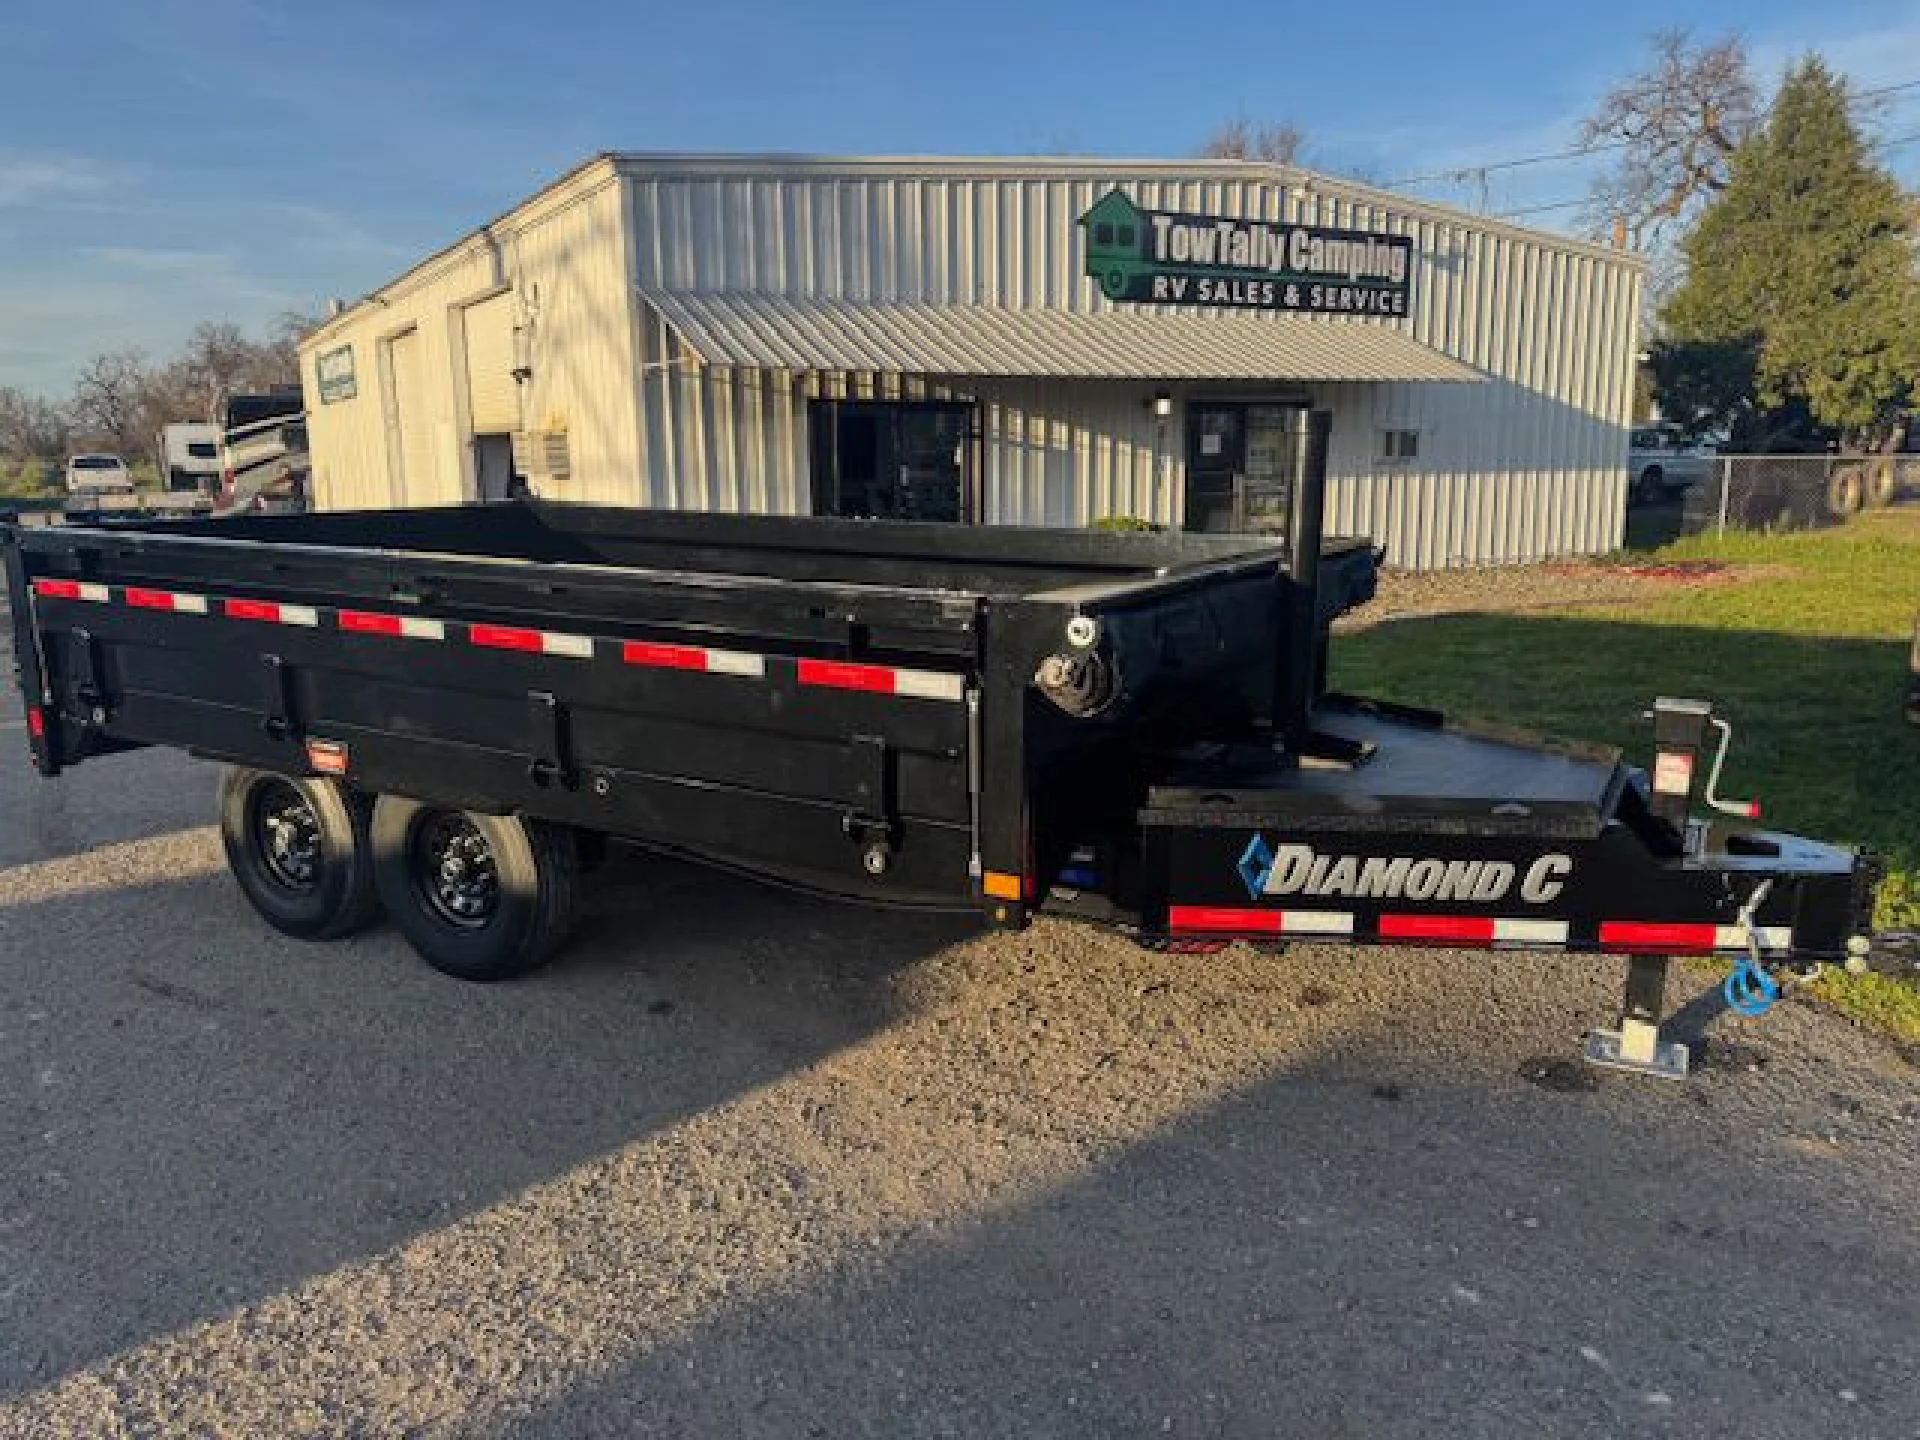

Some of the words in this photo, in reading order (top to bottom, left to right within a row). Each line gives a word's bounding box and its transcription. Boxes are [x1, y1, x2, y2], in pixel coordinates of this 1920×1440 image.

[1152, 215, 1284, 271] TowTally
[1289, 228, 1405, 282] Camping
[1154, 276, 1188, 298] RV
[1198, 279, 1273, 304] SALES
[1283, 285, 1300, 307] &
[1310, 285, 1402, 311] SERVICE
[1264, 843, 1516, 900] DIAMOND
[1520, 854, 1573, 903] C
